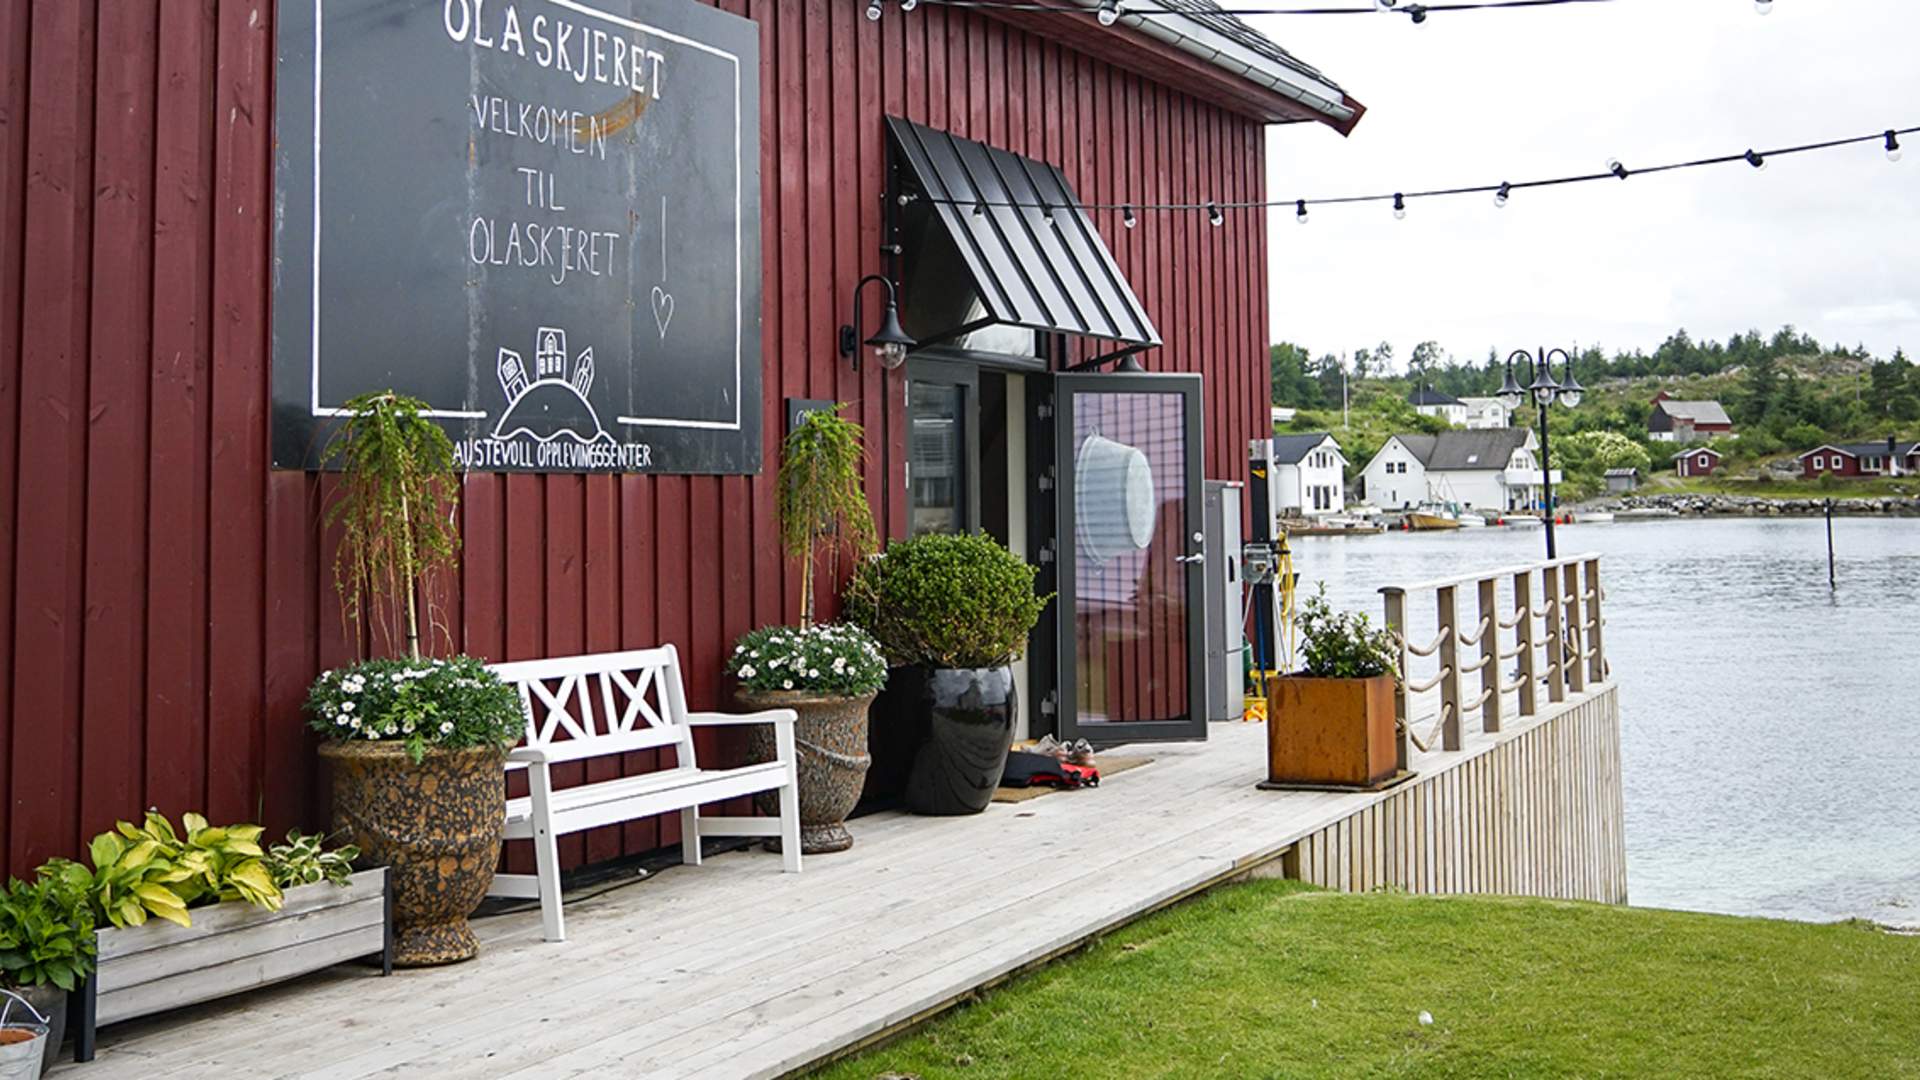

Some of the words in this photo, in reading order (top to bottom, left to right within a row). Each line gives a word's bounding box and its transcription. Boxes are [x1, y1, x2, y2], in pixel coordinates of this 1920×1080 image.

[444, 0, 664, 100] OLASKJERET
[472, 95, 606, 160] VELKOMEN
[518, 168, 565, 211] TIL
[470, 217, 619, 284] OLASKJERET
[453, 439, 534, 467] AUSTEVOLL
